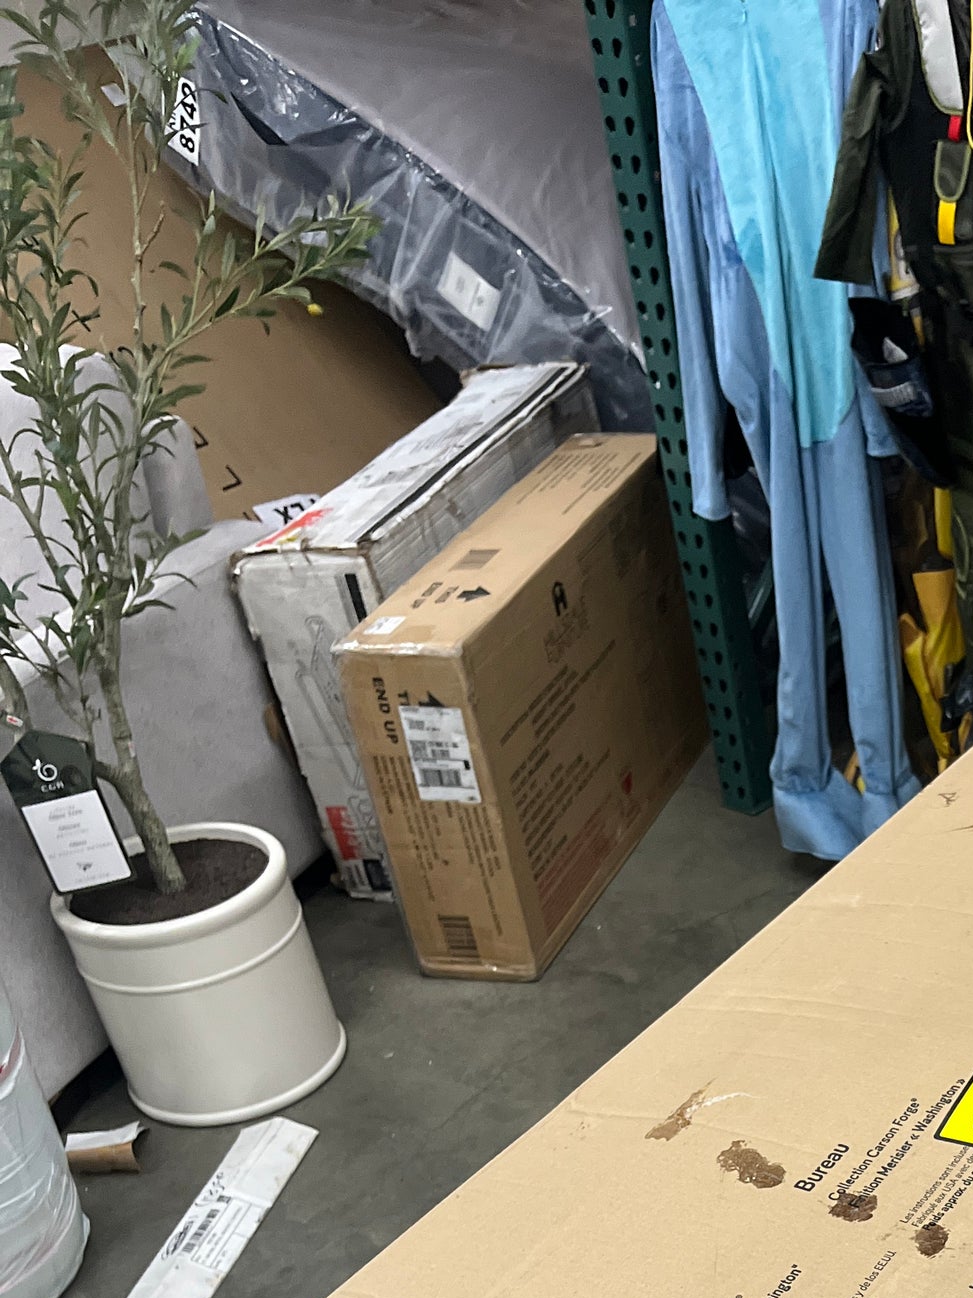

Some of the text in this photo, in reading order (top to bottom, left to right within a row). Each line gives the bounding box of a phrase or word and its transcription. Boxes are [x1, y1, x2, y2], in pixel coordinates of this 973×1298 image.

[372, 677, 399, 744] END UP
[877, 1140, 914, 1177] Merisier
[912, 1083, 961, 1134] Washington
[793, 1143, 850, 1192] Bureau
[828, 1158, 873, 1202] Collection
[866, 1127, 899, 1159] Carson
[900, 1145, 969, 1224] Les instructions sont incluse
[934, 1192, 947, 1204] aux
[942, 1179, 958, 1193] USA
[955, 1164, 970, 1178] avec
[922, 1212, 945, 1231] Poids
[941, 1186, 967, 1212] approx.
[860, 1280, 871, 1291] de
[868, 1271, 880, 1282] los
